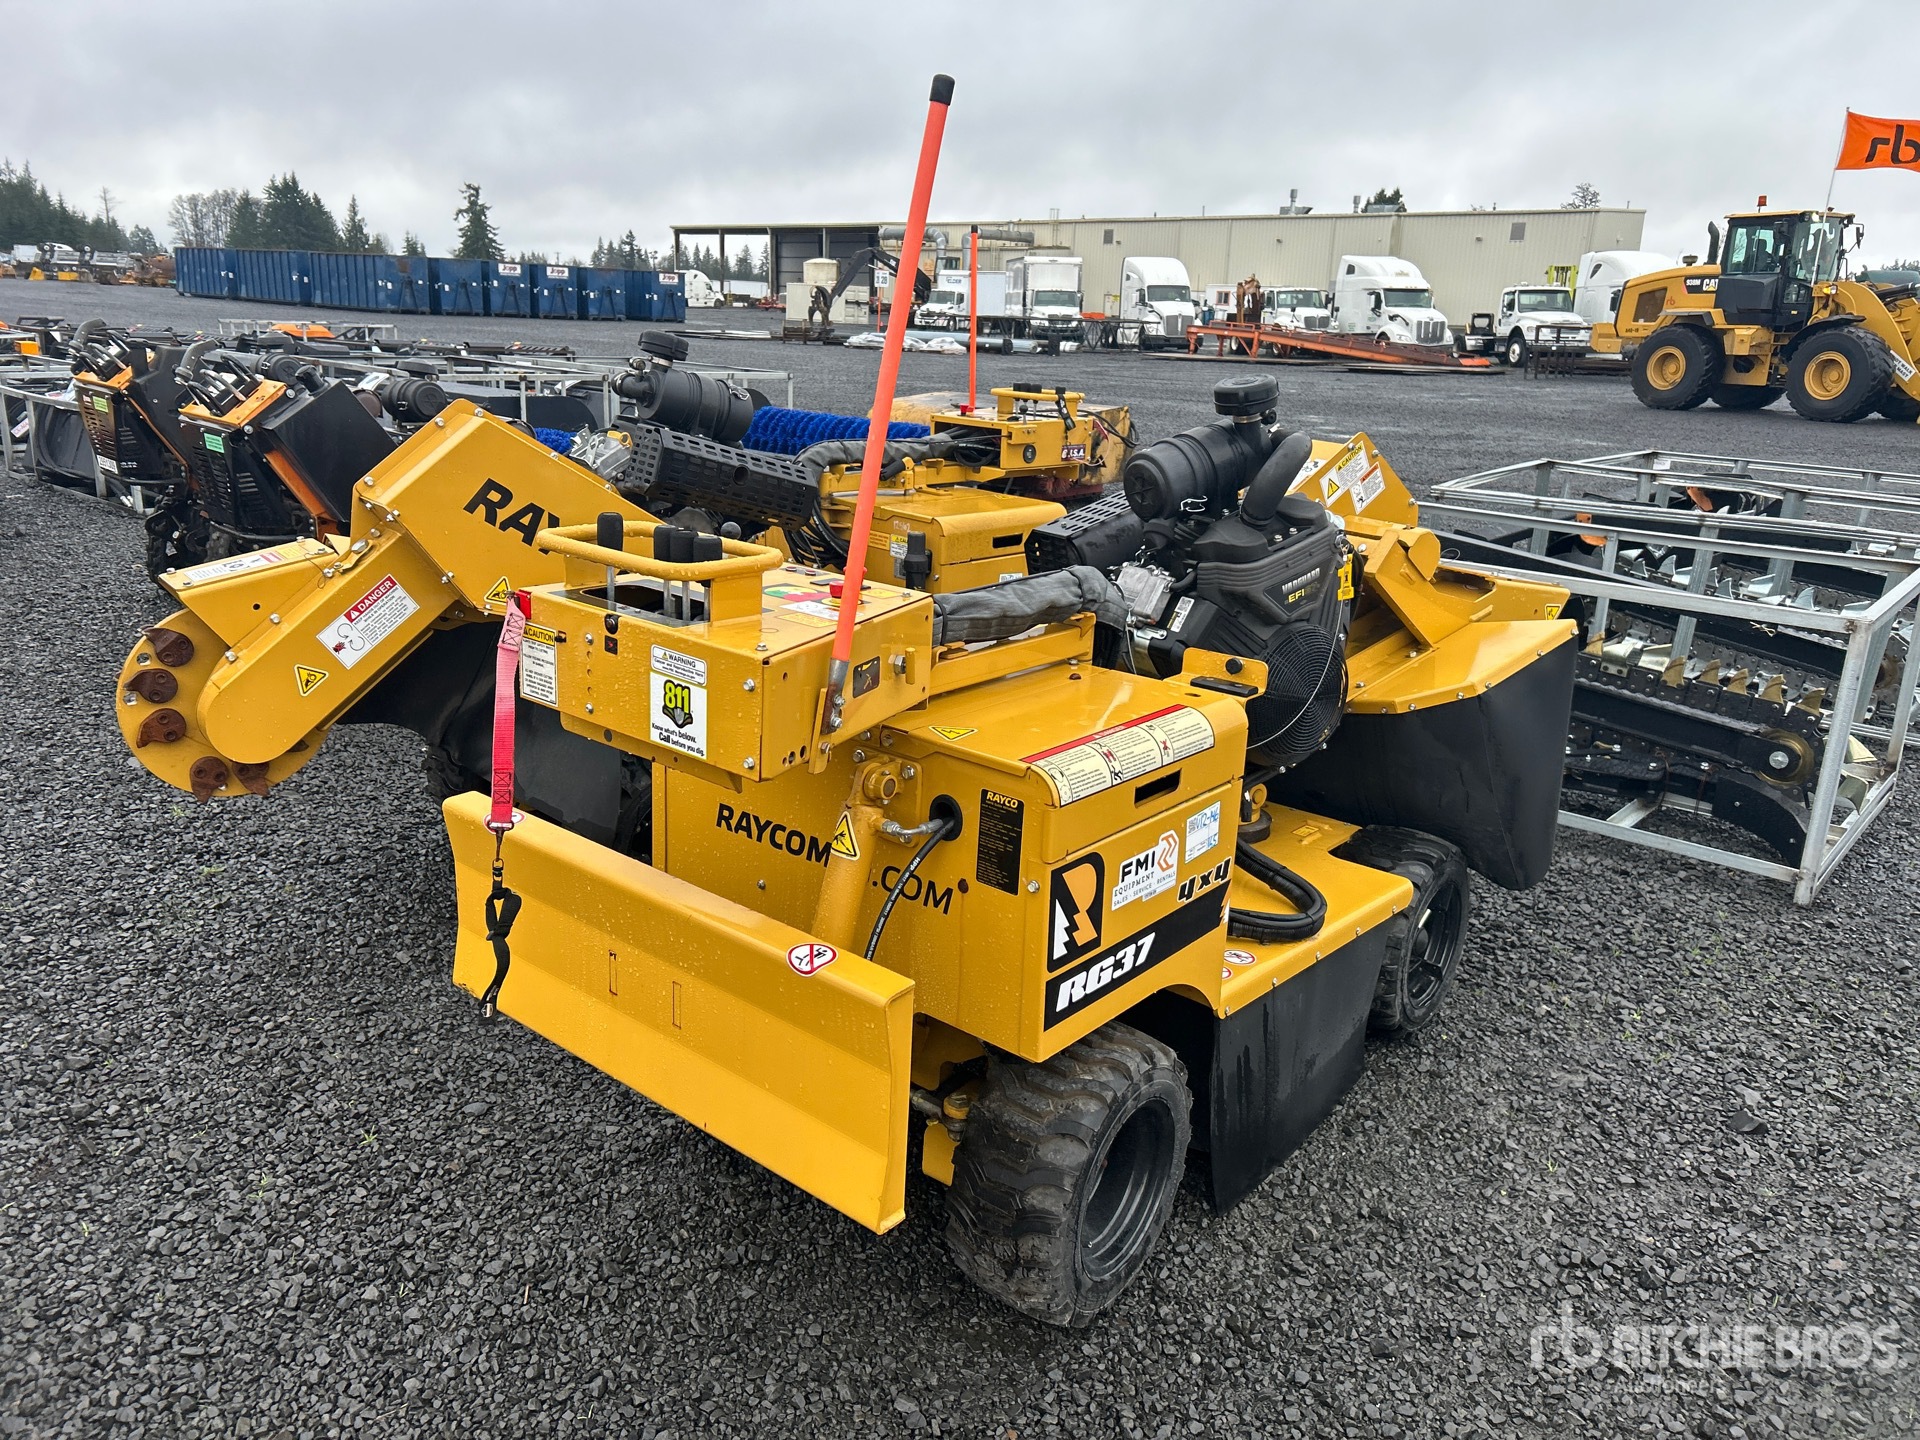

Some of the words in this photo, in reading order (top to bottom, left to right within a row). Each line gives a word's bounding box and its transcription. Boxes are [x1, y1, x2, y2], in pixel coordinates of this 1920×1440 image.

[1703, 279, 1719, 291] CAT
[358, 580, 393, 611] DANGER
[1288, 590, 1305, 603] EFI
[527, 628, 554, 642] CAUTION
[668, 653, 696, 668] WARNING
[664, 680, 690, 714] 811
[652, 722, 664, 731] Know
[678, 730, 697, 743] below.
[659, 732, 671, 744] Call
[671, 738, 686, 749] before
[686, 743, 696, 752] you
[695, 745, 705, 757] dig.
[986, 791, 1018, 809] RAYCO
[1120, 850, 1156, 883] FMI
[1113, 894, 1128, 907] SALES
[1133, 882, 1152, 897] SERVICE
[1156, 870, 1176, 885] RENTALS
[1114, 871, 1155, 897] EQUIPMENT
[1056, 931, 1156, 1012] RG37
